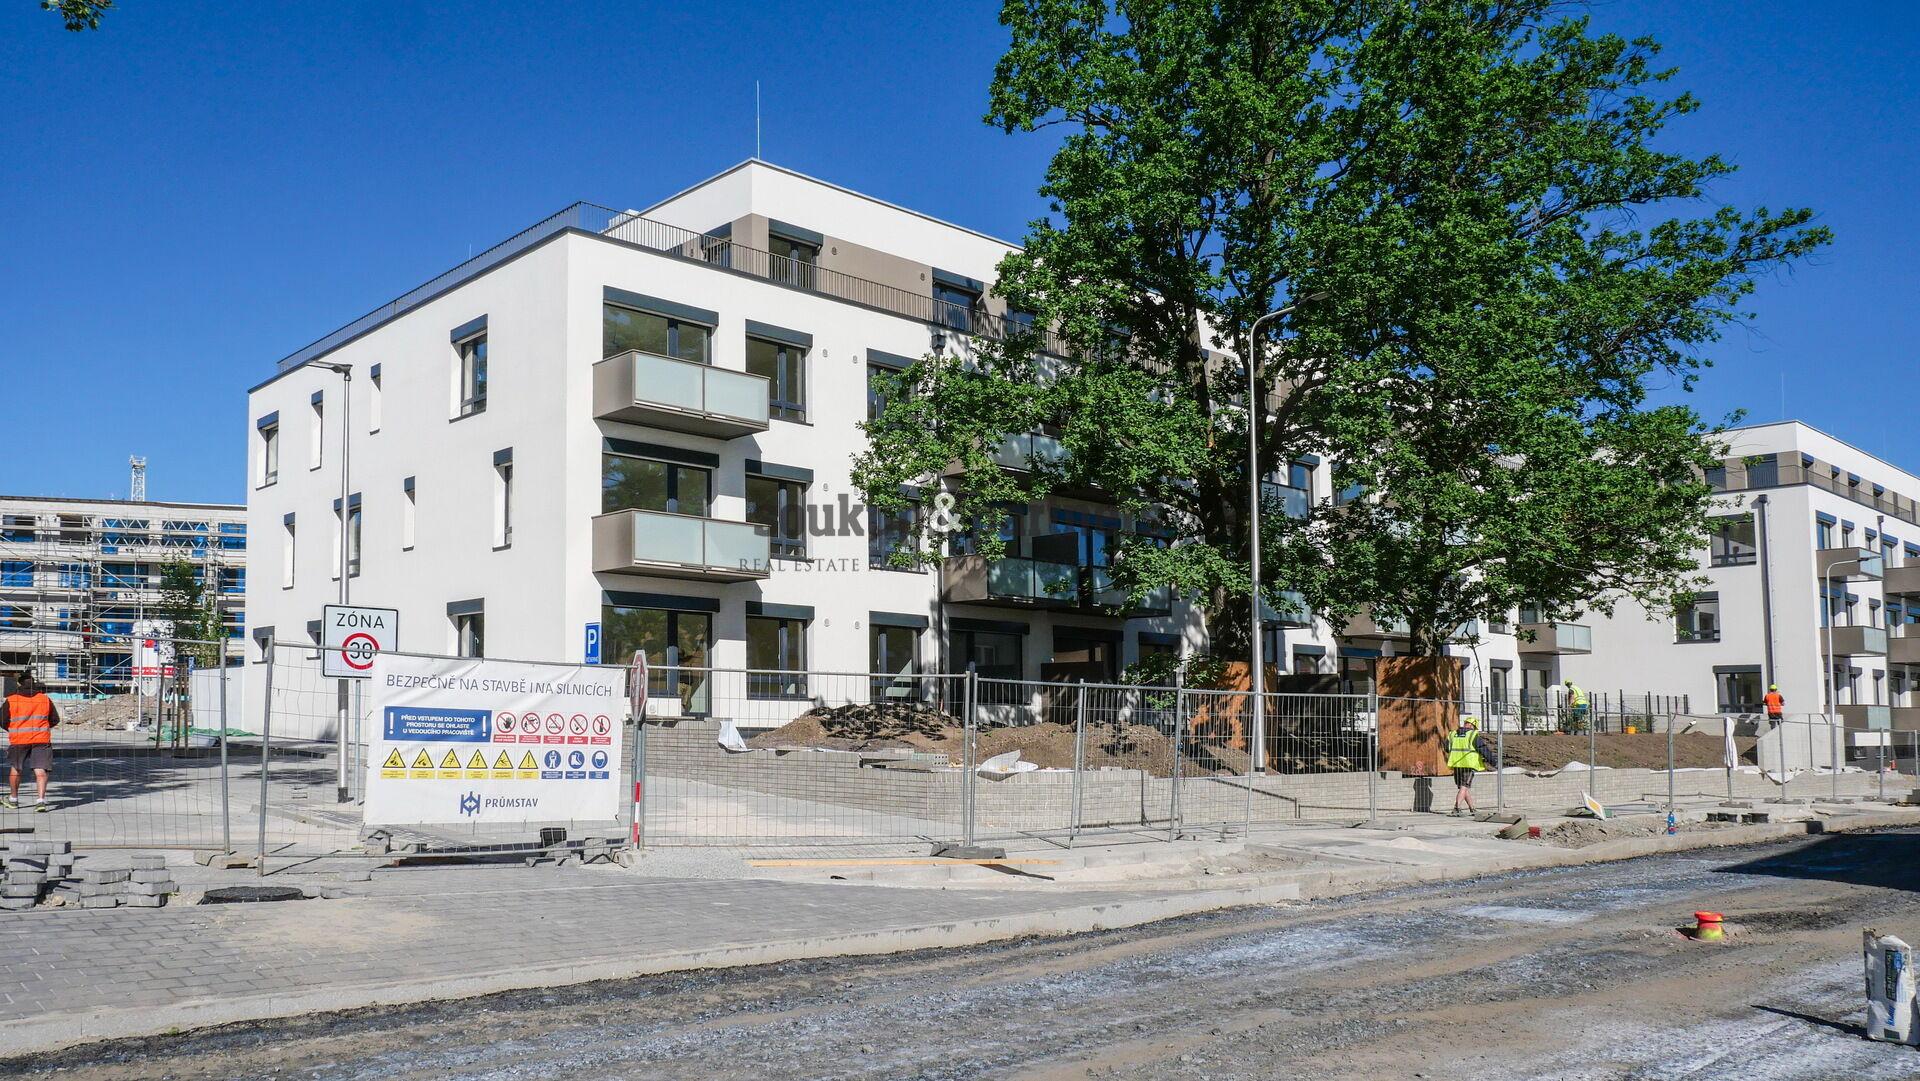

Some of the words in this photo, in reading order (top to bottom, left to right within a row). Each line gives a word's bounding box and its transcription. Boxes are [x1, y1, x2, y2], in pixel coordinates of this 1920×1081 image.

[336, 610, 384, 629] ZÓNA
[587, 628, 597, 654] P
[350, 642, 373, 660] 30
[386, 674, 456, 690] BEZPEČNĚ
[460, 678, 478, 691] NA
[482, 678, 526, 693] STAVBĚ
[535, 682, 553, 694] NA
[556, 682, 612, 697] SILNICÍCH
[485, 796, 538, 808] PRŮMSTAV
